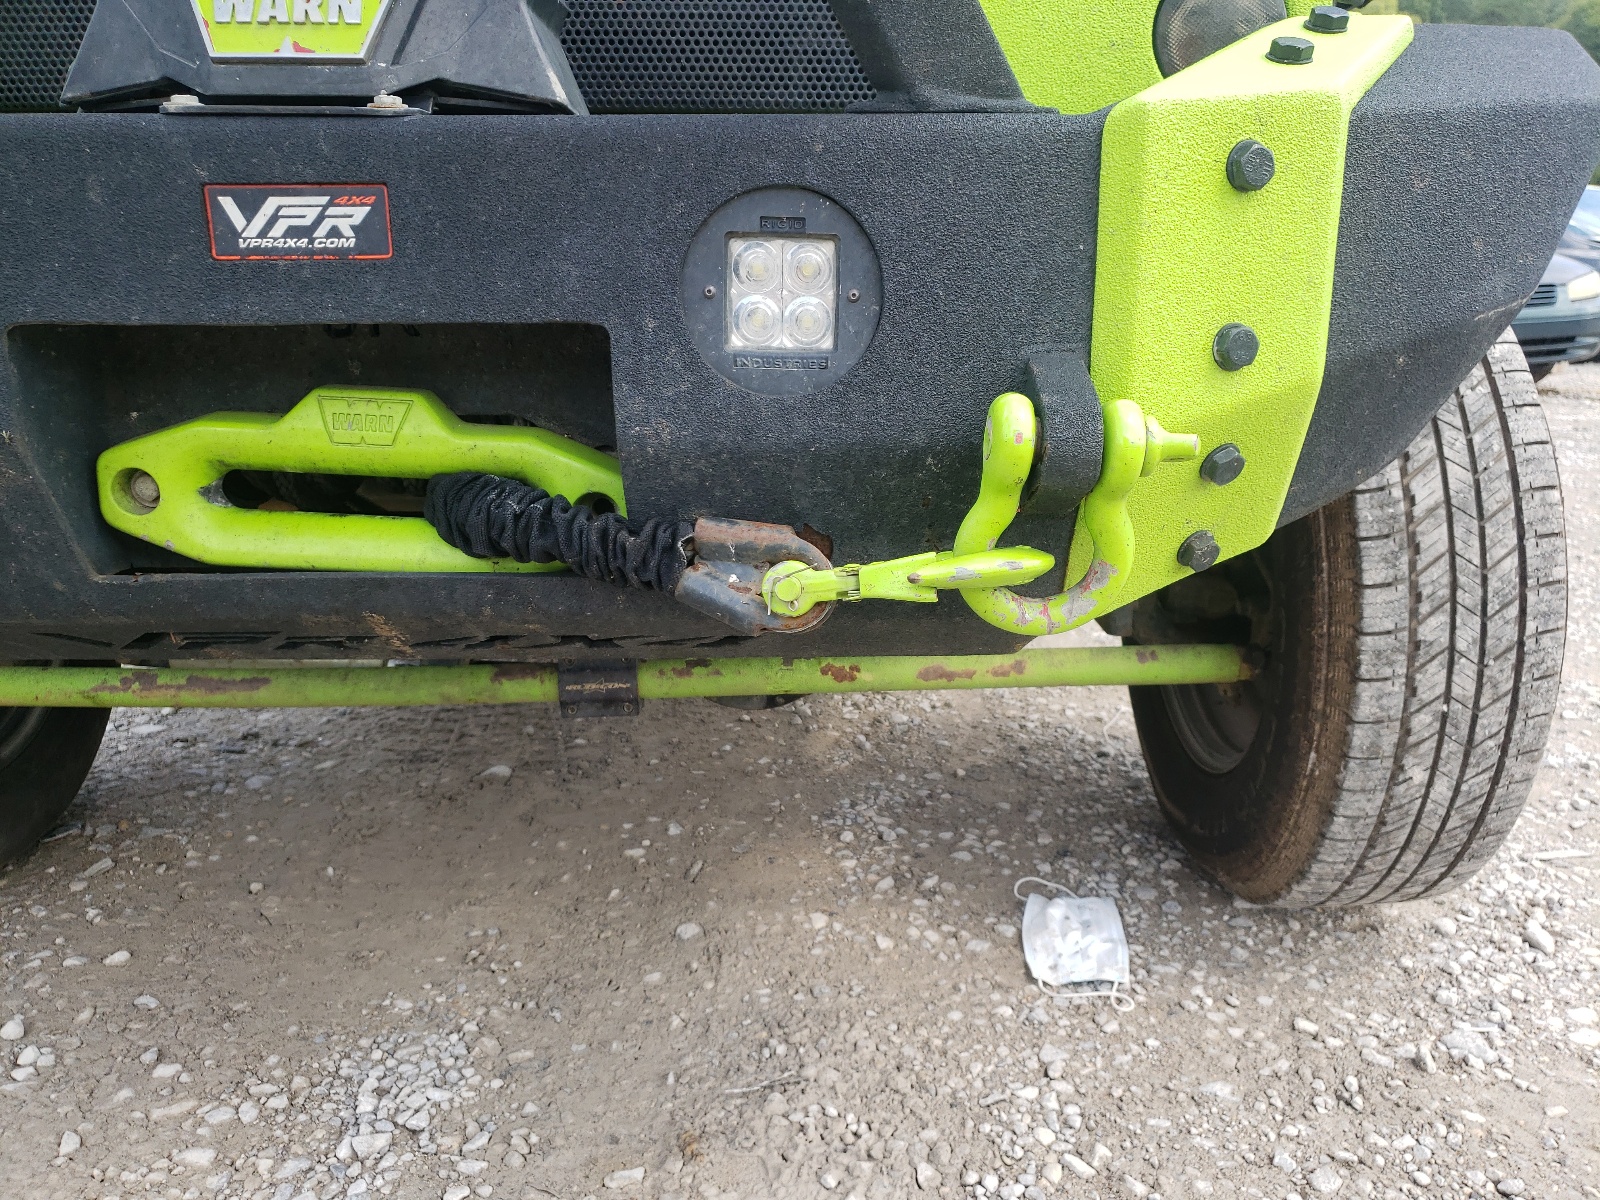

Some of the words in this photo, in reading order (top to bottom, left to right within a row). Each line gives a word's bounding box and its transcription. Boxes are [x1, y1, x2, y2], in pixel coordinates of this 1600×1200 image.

[213, 0, 362, 24] WARN
[217, 196, 371, 238] VPR
[760, 218, 805, 229] RIGID
[238, 238, 356, 248] VPR4X4.COM
[735, 356, 828, 370] INDUSTRIES
[332, 412, 394, 433] WARN
